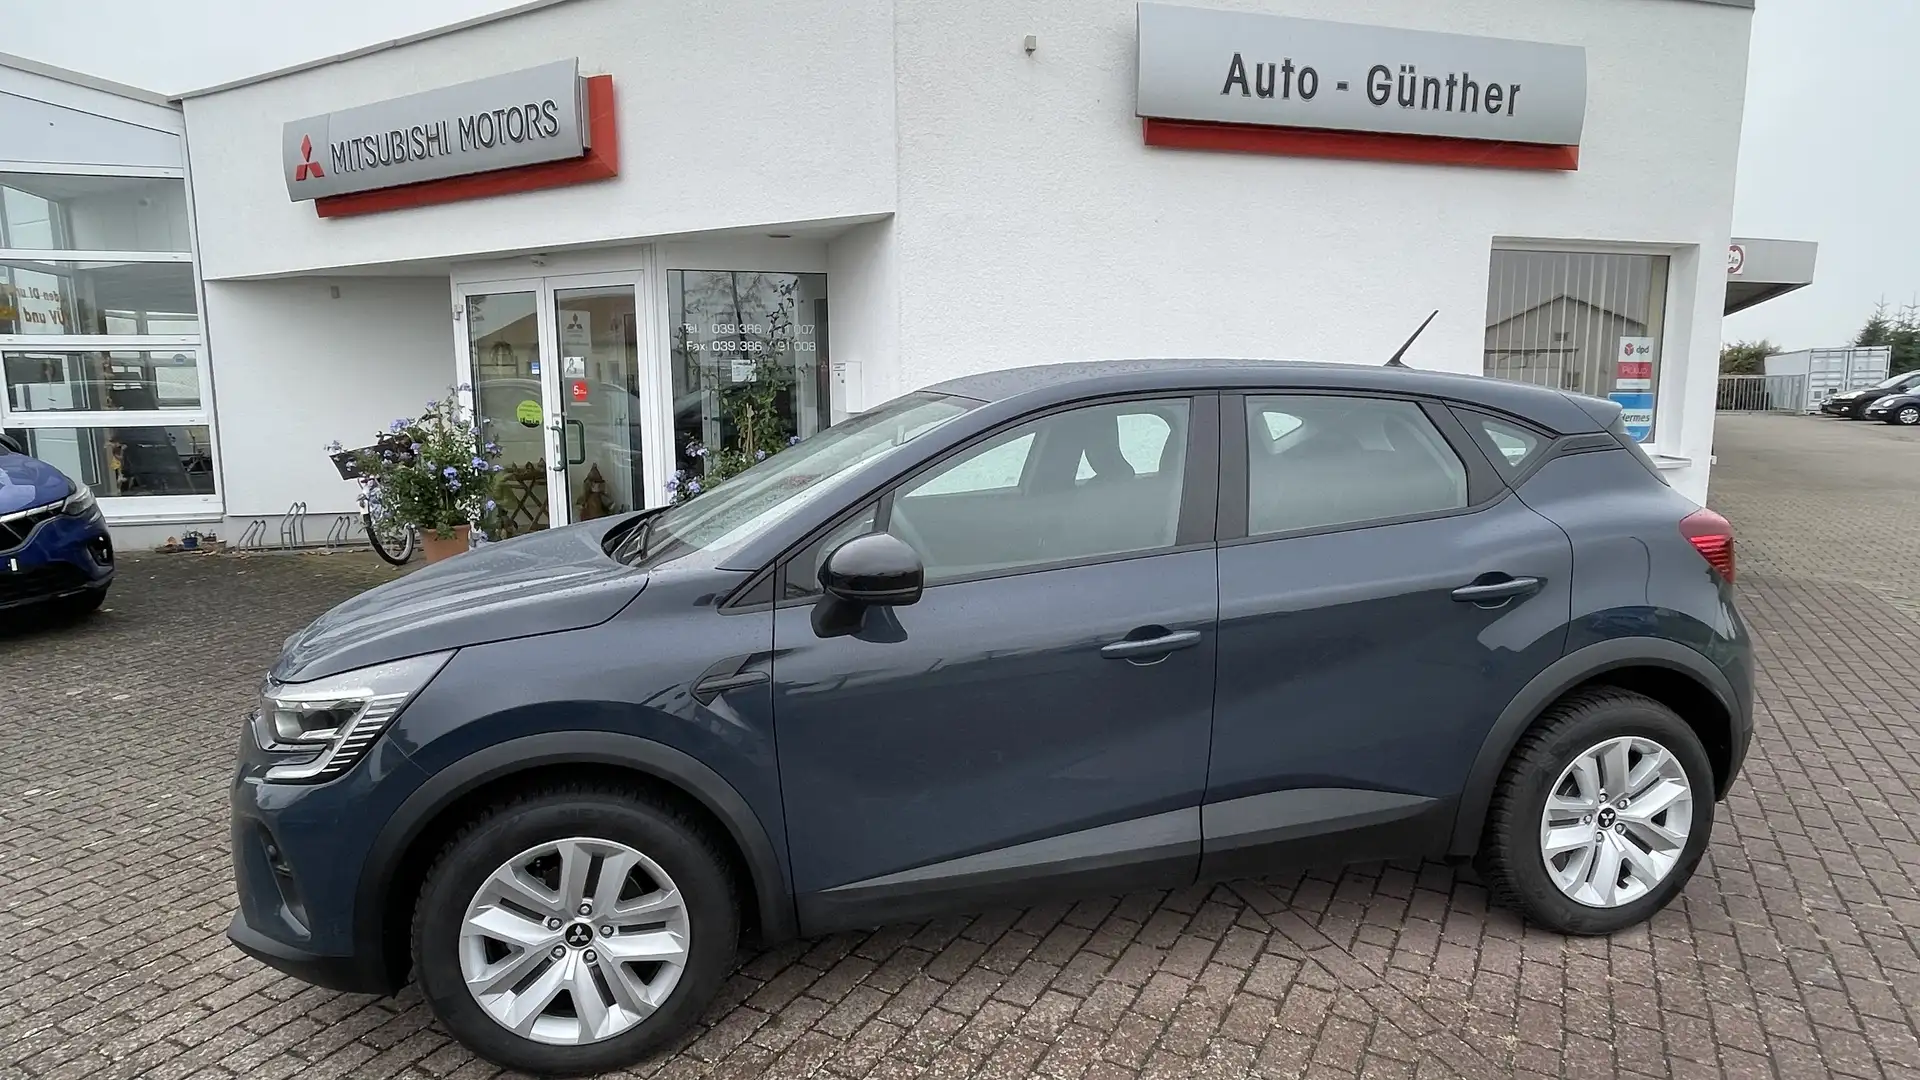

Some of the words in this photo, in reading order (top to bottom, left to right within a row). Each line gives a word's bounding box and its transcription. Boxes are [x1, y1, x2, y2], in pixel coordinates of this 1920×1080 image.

[1220, 52, 1319, 102] Auto
[1366, 64, 1521, 116] Günther
[331, 120, 451, 174] MITSUBISHI
[458, 99, 560, 152] MOTORS
[711, 323, 735, 334] 039
[739, 323, 762, 334] 386
[793, 324, 815, 335] 007
[712, 341, 736, 351] 039
[739, 341, 762, 351] 386
[777, 341, 790, 351] 91
[793, 341, 816, 352] 008
[1636, 345, 1649, 354] dpd
